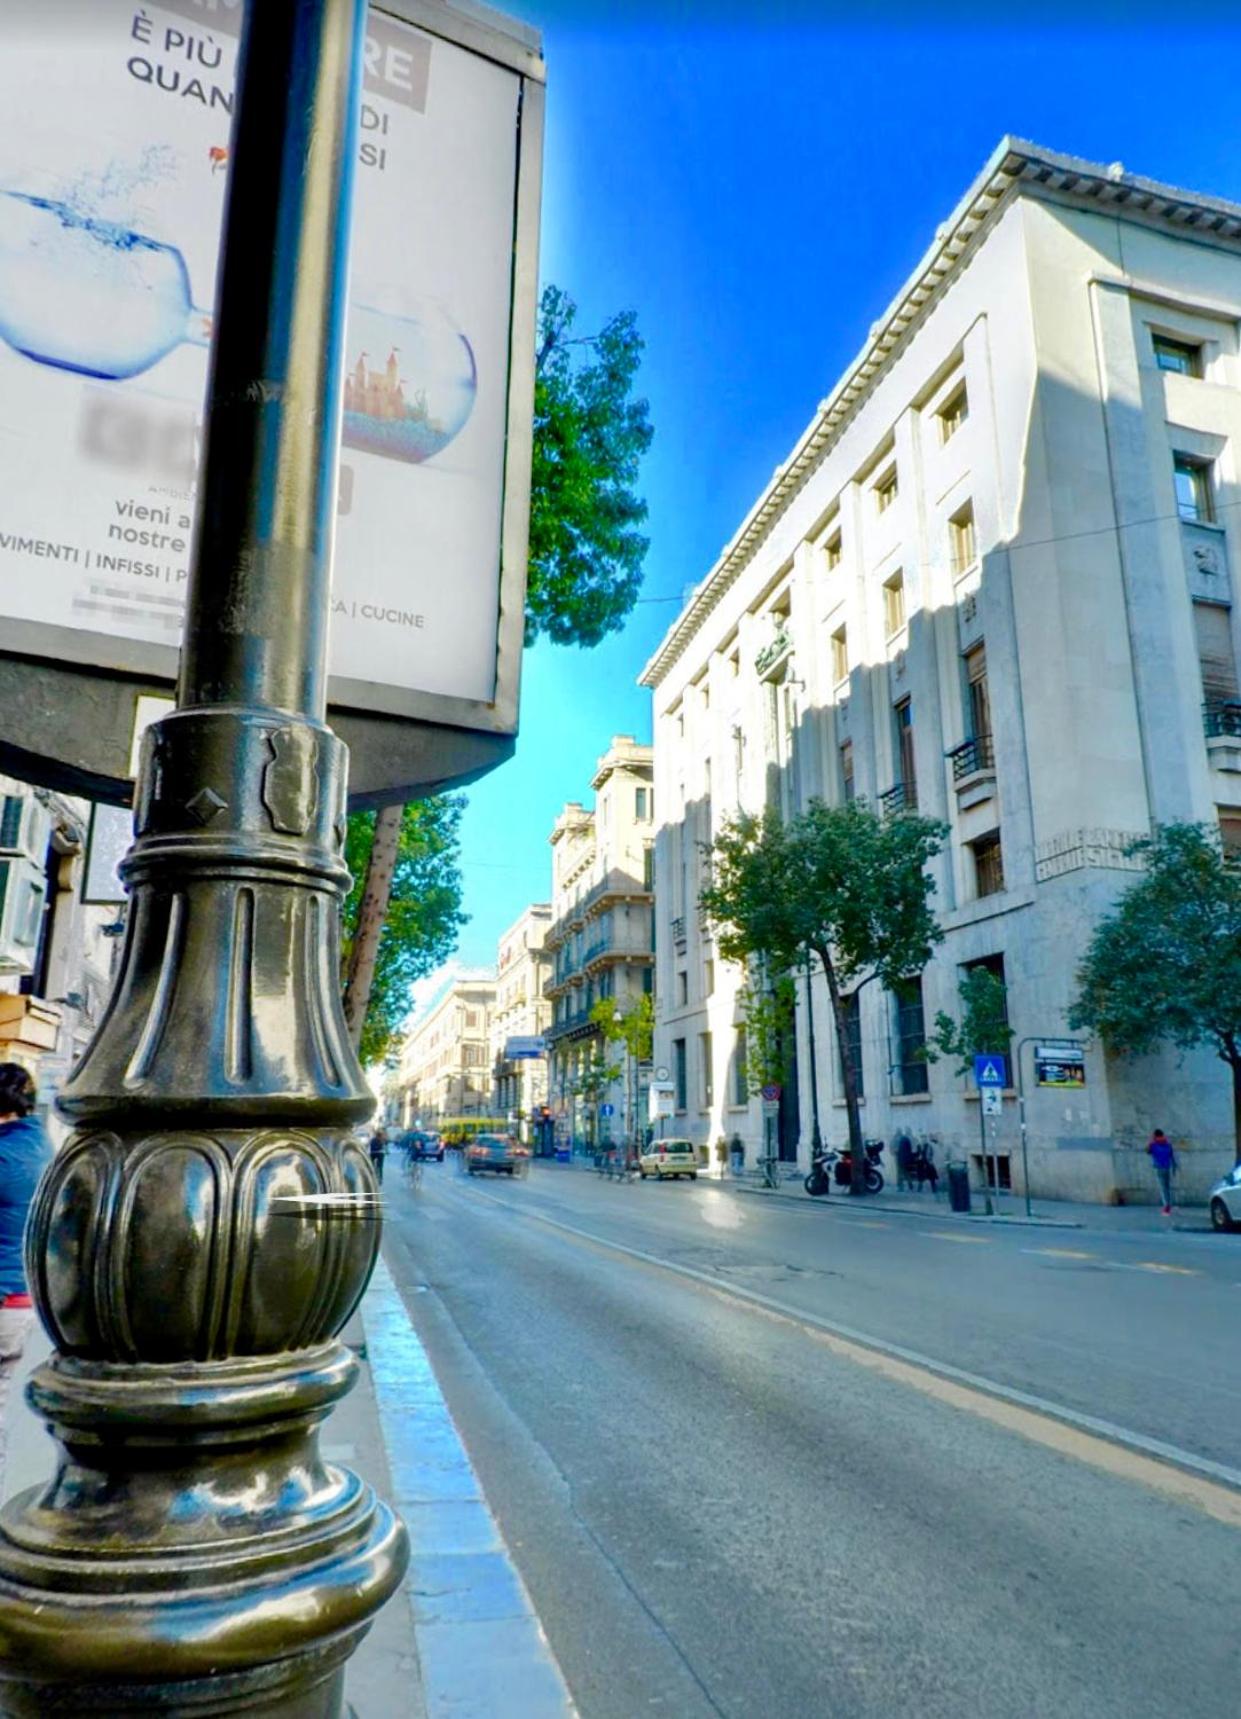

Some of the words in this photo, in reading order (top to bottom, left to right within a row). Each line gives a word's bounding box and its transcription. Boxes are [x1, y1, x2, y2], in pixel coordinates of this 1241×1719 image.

[131, 8, 153, 45] È
[165, 27, 222, 69] PIÙ
[115, 499, 171, 526] vieni
[108, 523, 186, 552] nostre
[96, 552, 160, 579] INFISSI
[361, 604, 424, 629] CUCINE
